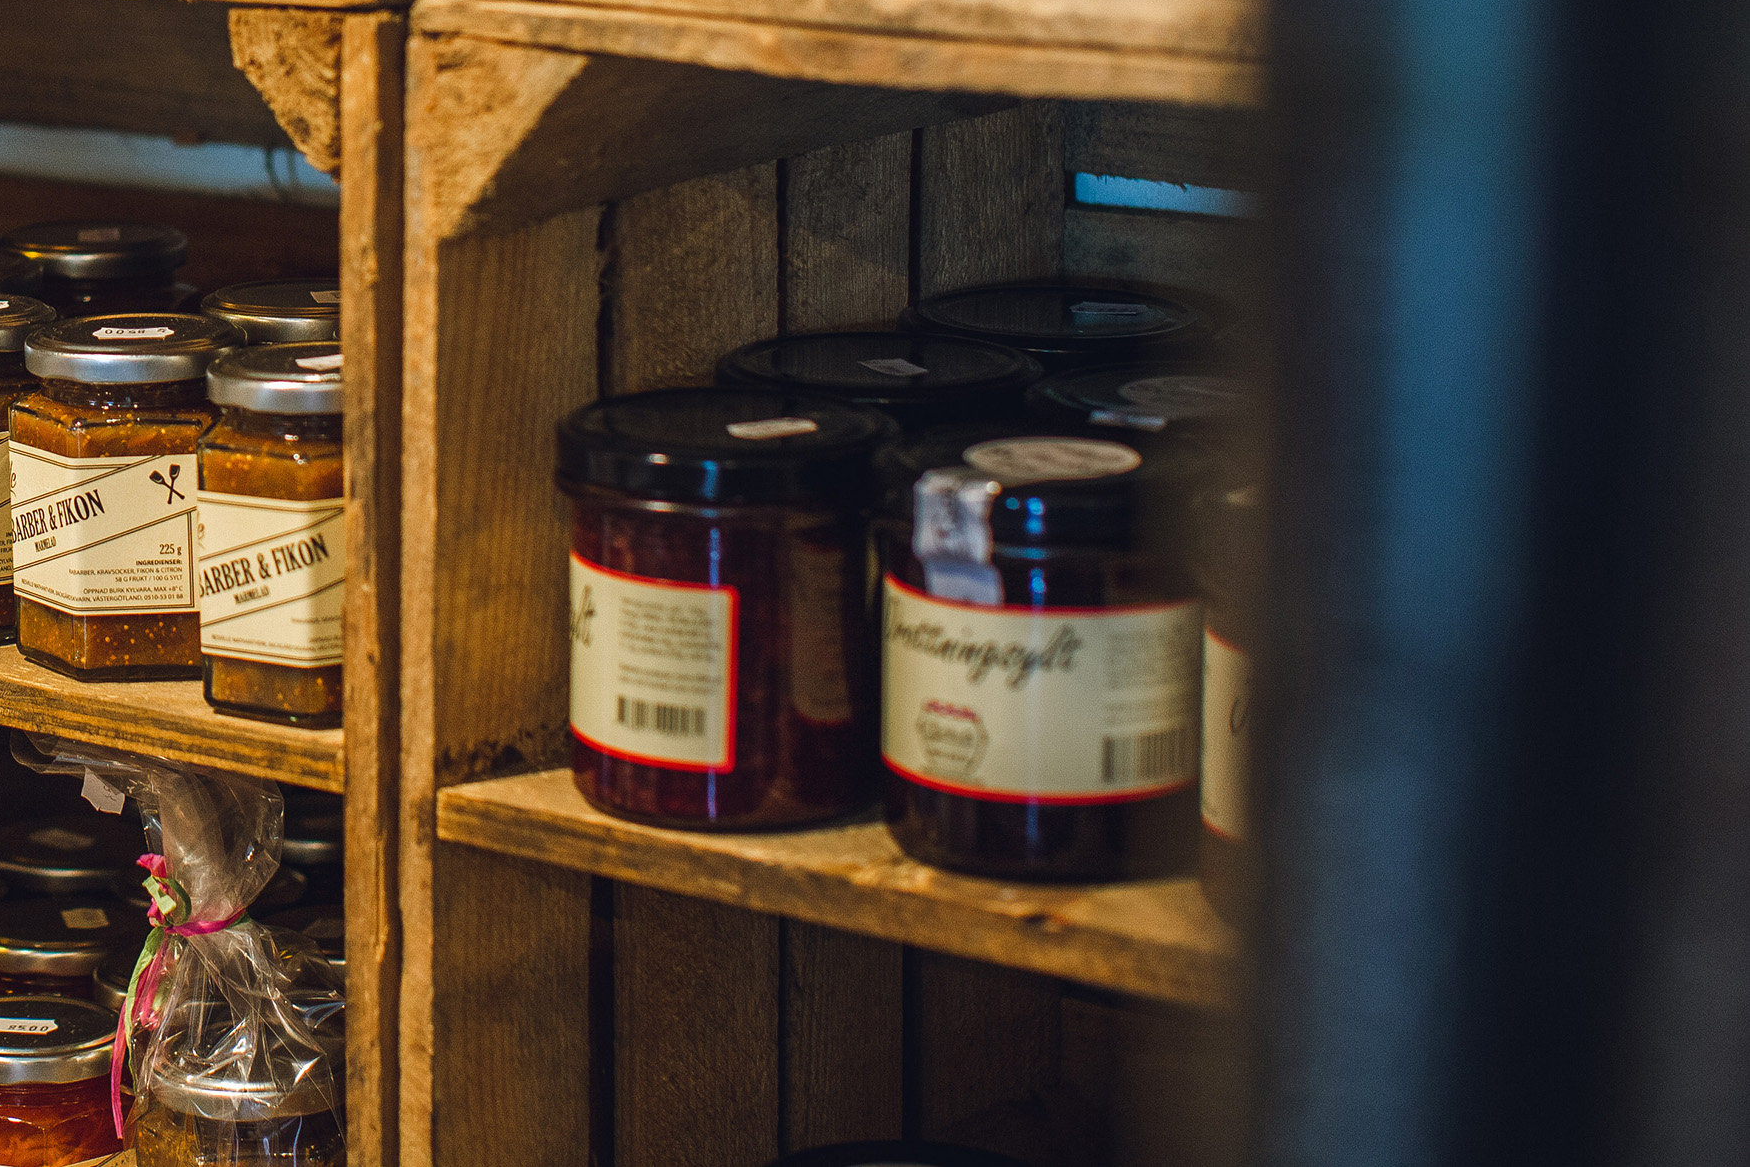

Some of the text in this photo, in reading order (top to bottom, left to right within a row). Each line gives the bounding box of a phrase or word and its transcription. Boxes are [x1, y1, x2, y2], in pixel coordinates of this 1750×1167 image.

[11, 489, 106, 544] BARBER & FIKON
[159, 543, 182, 556] 225 g
[256, 552, 271, 580] &
[270, 532, 330, 576] FIKON
[97, 568, 136, 576] KRAVSOCKER,
[83, 587, 108, 595] ÖPPNAD
